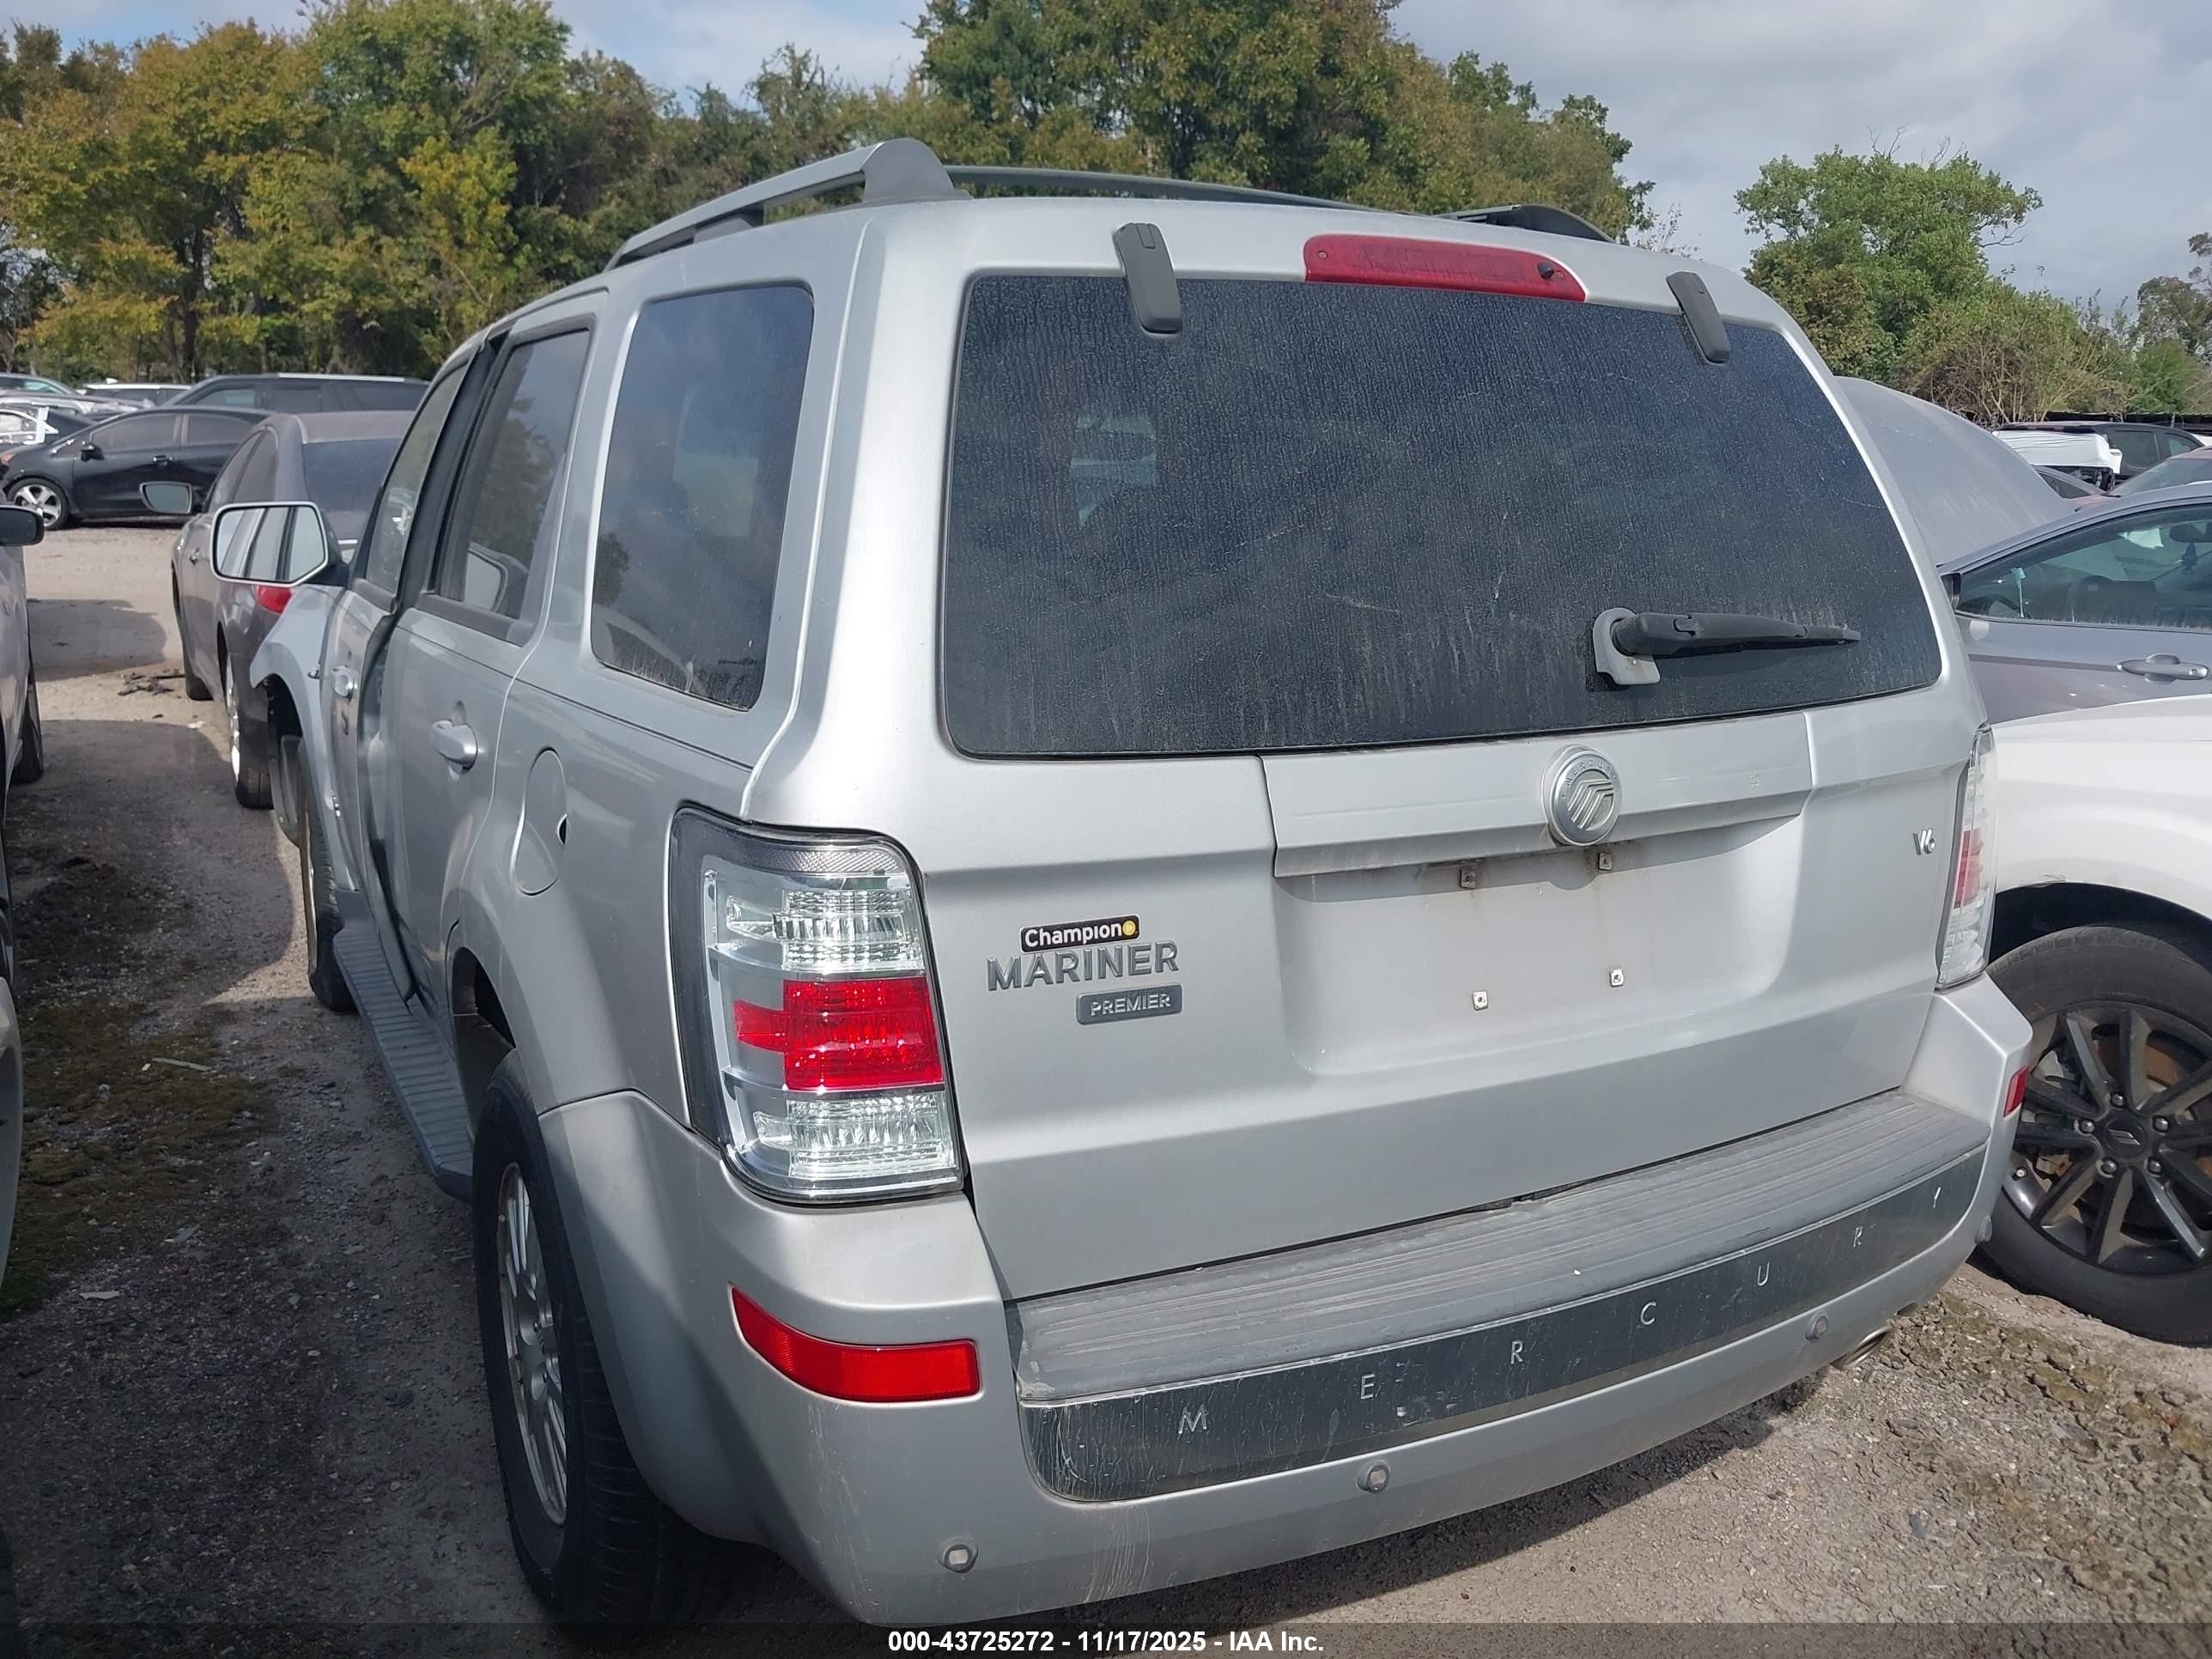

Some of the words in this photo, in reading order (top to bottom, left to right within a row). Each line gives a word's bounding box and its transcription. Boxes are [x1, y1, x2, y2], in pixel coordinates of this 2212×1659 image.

[1912, 828, 1936, 856] V6
[1024, 922, 1122, 947] Champion
[987, 939, 1180, 992] MARINER
[1090, 993, 1172, 1017] PREMIER
